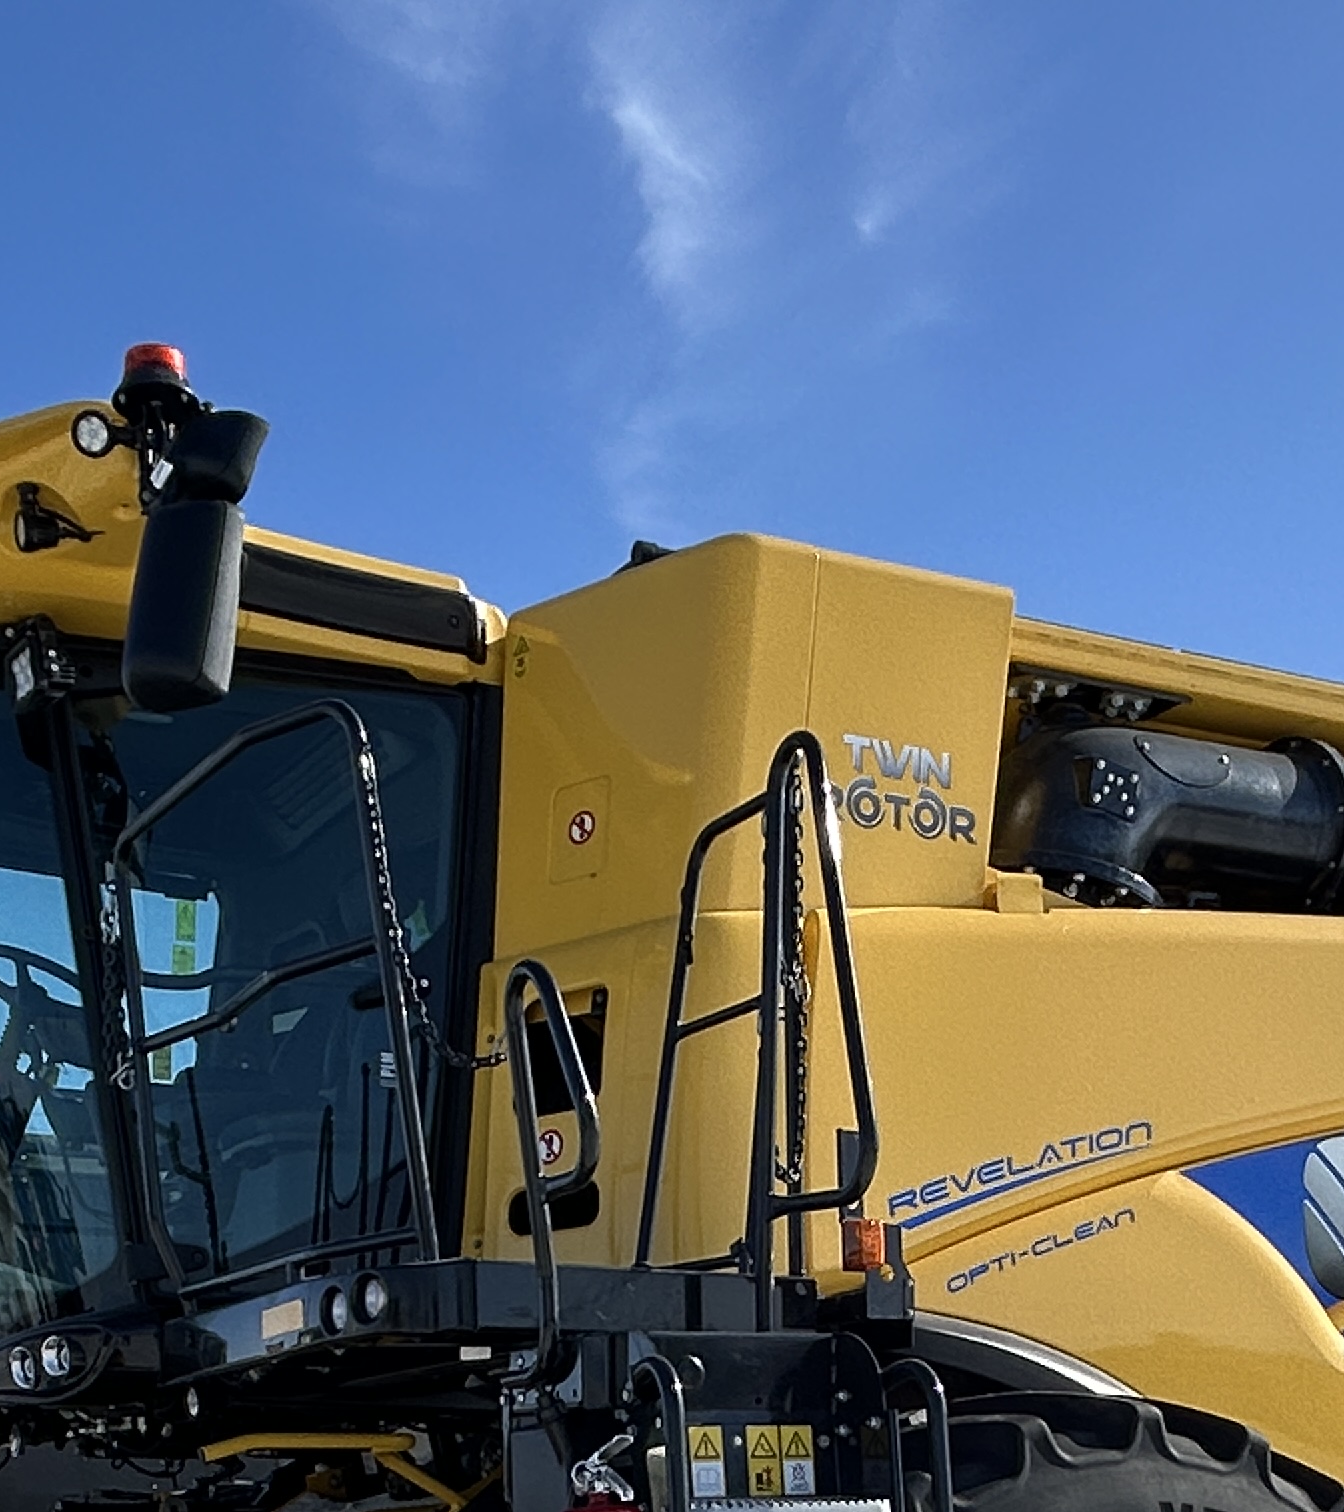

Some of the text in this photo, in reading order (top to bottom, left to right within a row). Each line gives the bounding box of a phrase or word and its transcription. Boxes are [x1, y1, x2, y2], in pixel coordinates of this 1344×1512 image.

[842, 732, 951, 790] TWIN
[888, 1120, 1153, 1218] REVELATION
[946, 1207, 1136, 1294] OPTI-CLEAN
